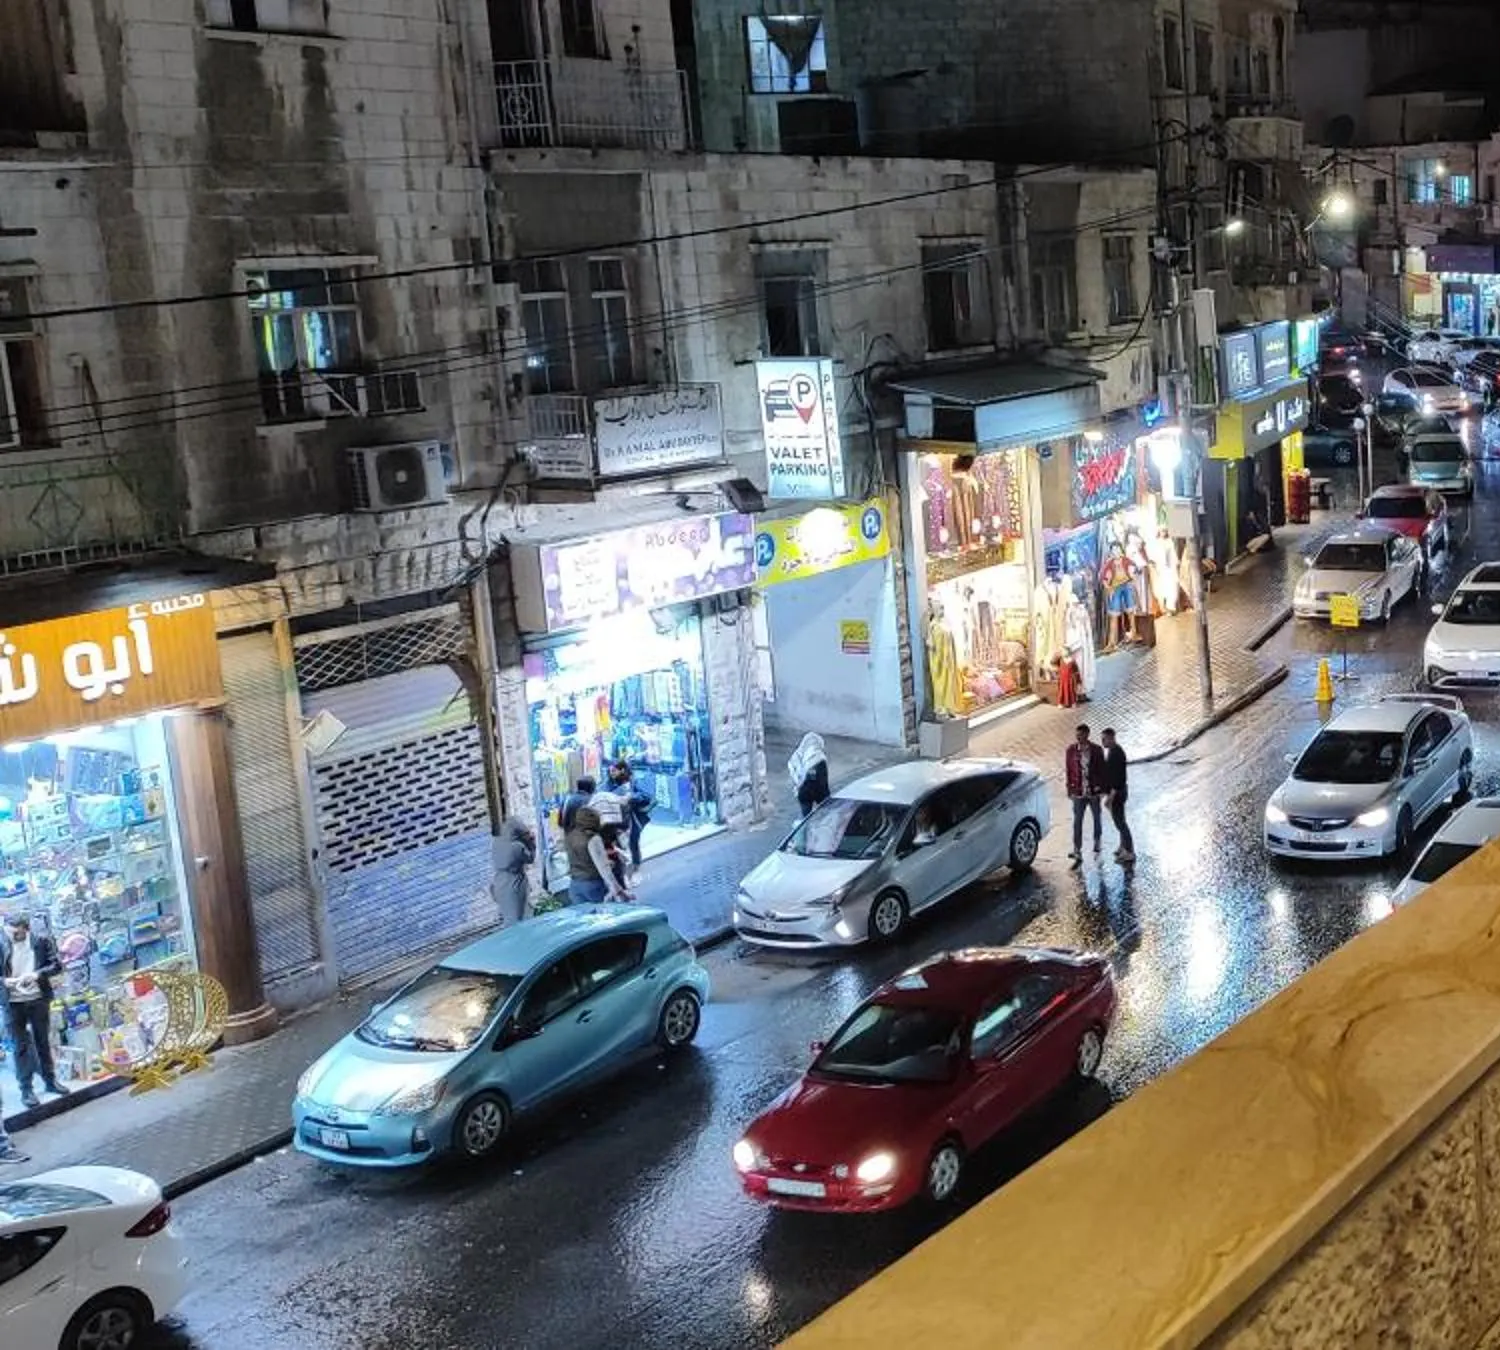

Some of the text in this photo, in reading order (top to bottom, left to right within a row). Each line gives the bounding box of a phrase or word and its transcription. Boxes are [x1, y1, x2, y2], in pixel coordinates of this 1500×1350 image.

[769, 447, 823, 459] VALET
[769, 462, 828, 476] PARKING
[63, 604, 153, 701] أبو
